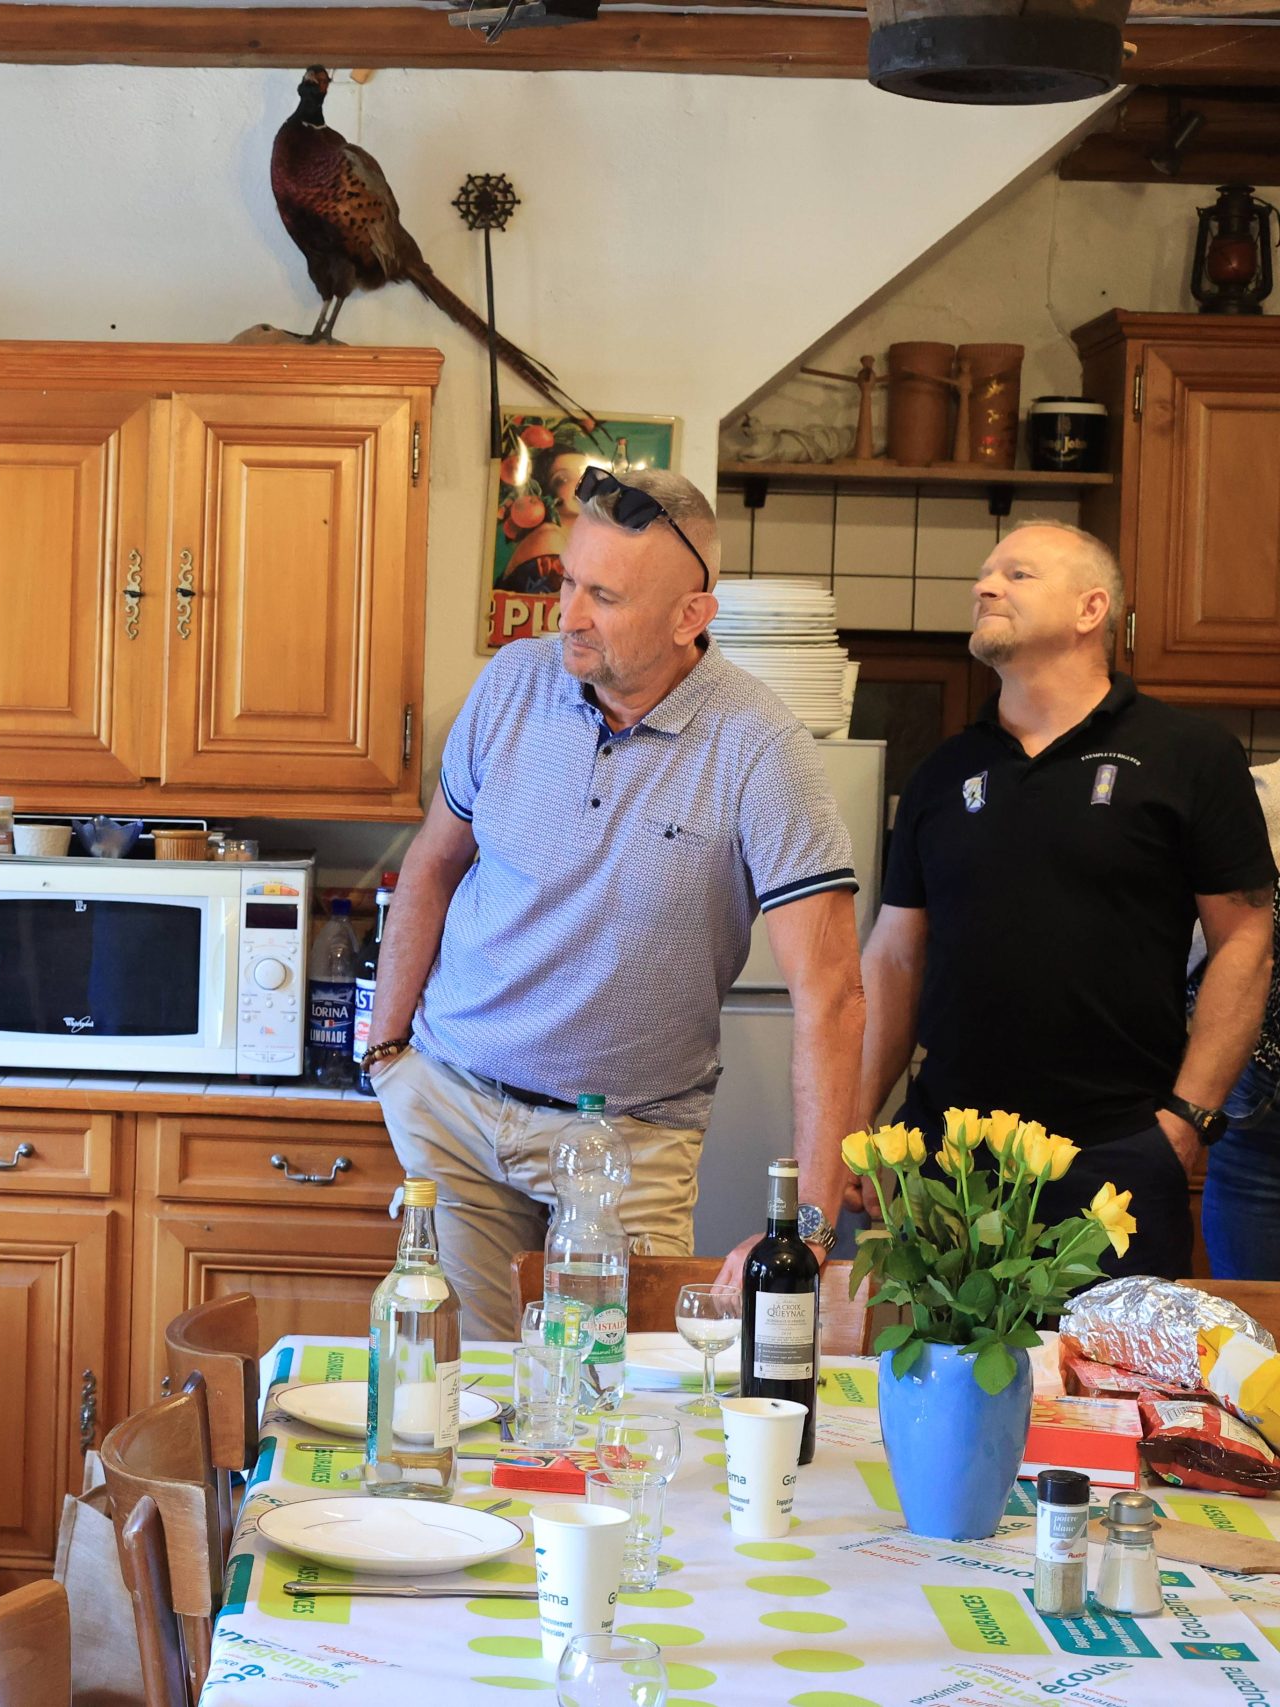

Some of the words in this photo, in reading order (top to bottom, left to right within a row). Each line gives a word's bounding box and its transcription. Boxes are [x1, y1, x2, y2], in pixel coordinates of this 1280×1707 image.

[312, 1004, 349, 1018] LORINA
[310, 1029, 347, 1043] LIMONADE
[767, 1308, 806, 1317] QUEYNAC
[325, 1352, 345, 1382] ASSURANCE
[833, 1372, 865, 1403] ASSURANCES
[1053, 1513, 1078, 1523] poivre
[1053, 1522, 1075, 1531] blanc
[937, 1555, 1035, 1580] onseil
[960, 1594, 1010, 1646] ASSURANCES
[1163, 1593, 1211, 1638] Groupama
[1037, 1661, 1134, 1694] écoute
[910, 1680, 975, 1705] proximité
